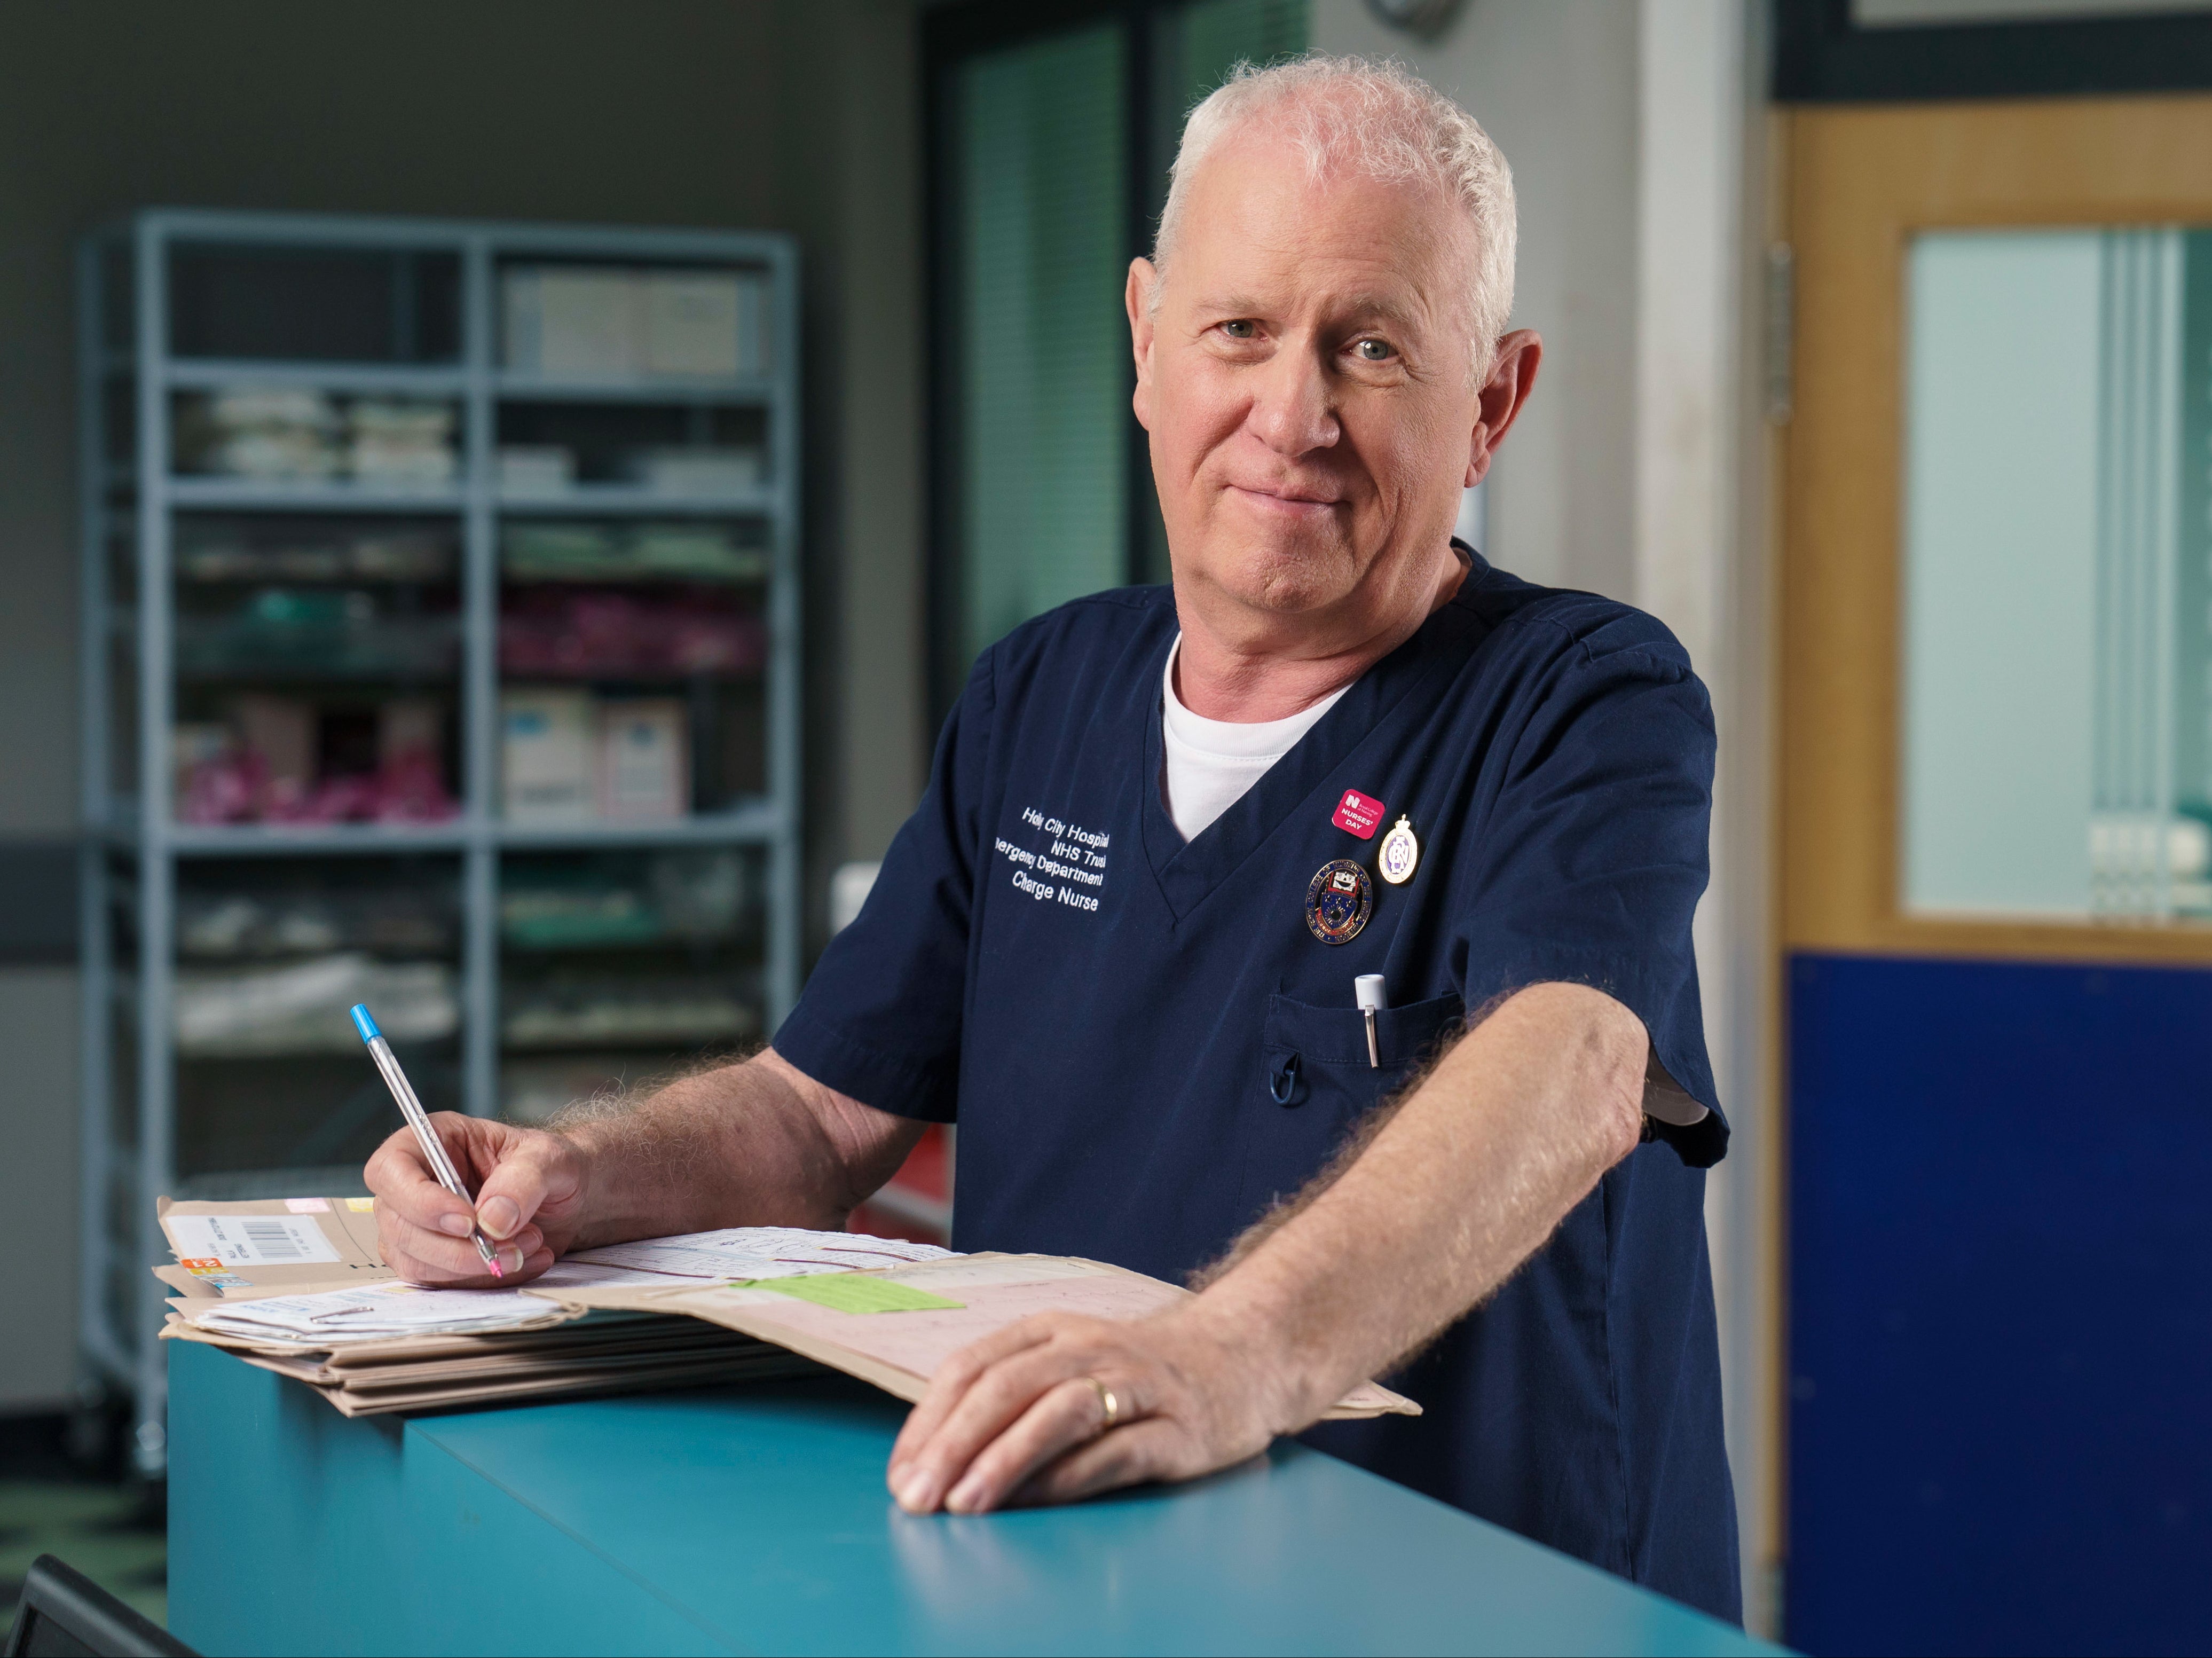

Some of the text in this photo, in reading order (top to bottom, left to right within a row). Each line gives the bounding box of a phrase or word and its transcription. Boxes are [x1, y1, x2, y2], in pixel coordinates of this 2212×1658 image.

[1341, 807, 1373, 826] NURSES'
[1345, 819, 1362, 830] DAY
[1044, 818, 1066, 838] City
[1051, 839, 1081, 861] NHS
[995, 837, 1104, 886] ergency Department
[1012, 870, 1099, 911] Charge Nurse
